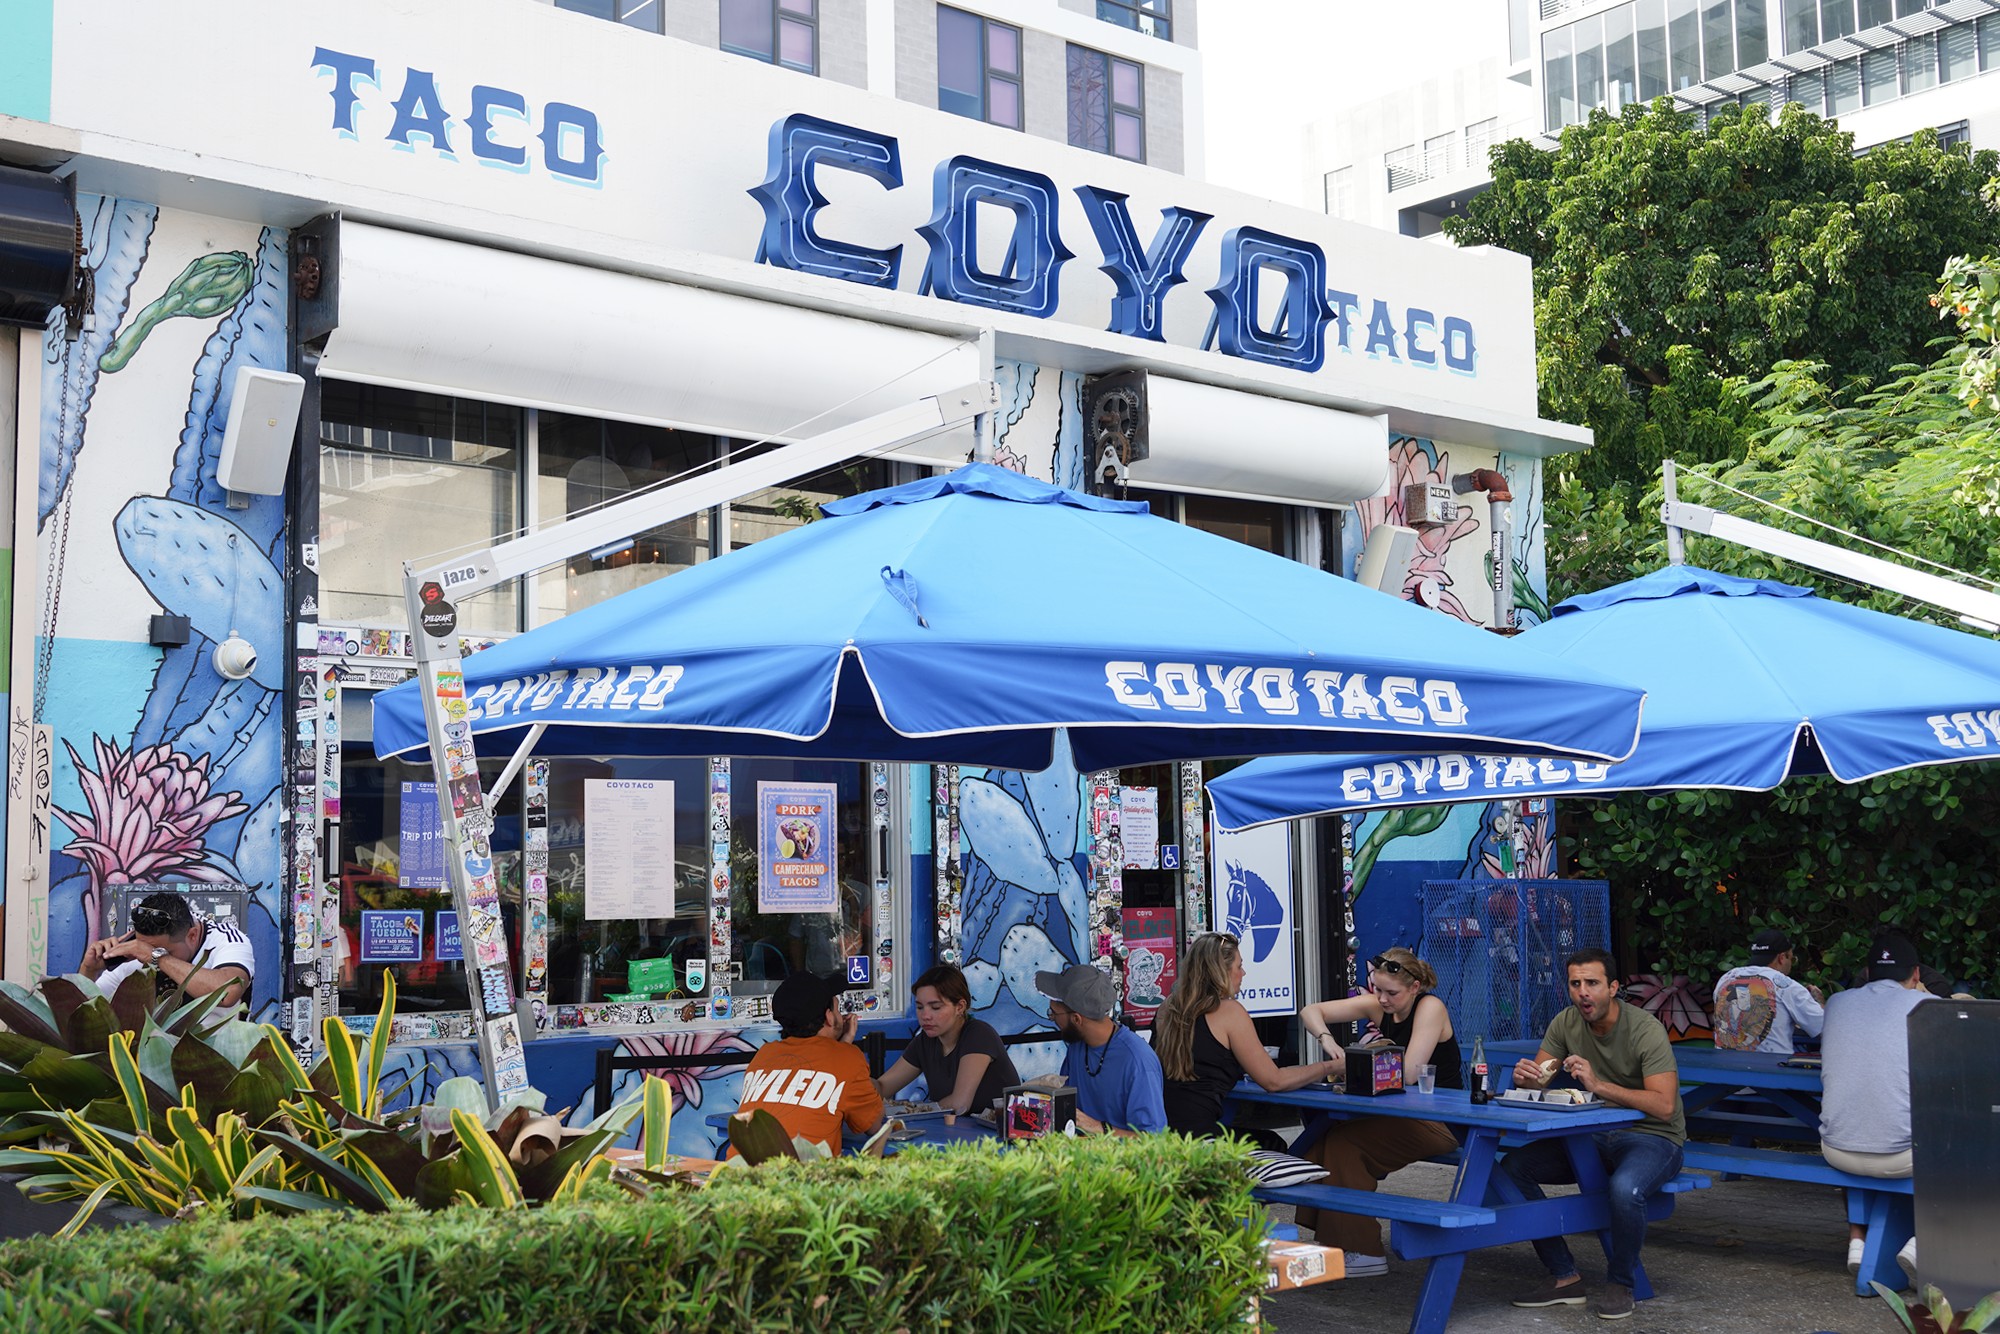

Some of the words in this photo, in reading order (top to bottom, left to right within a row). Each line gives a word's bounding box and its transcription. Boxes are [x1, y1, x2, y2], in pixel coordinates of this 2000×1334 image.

[310, 46, 610, 190] TACO
[746, 112, 1338, 373] COYO
[1325, 288, 1480, 377] TACO
[1431, 488, 1450, 498] NENA
[443, 567, 476, 587] jaze
[468, 670, 570, 721] COYO
[562, 665, 684, 711] TACO
[1105, 661, 1300, 716] COYO
[1302, 669, 1470, 727] TACO
[1339, 754, 1474, 801] COYO
[1475, 755, 1611, 789] TACO
[781, 805, 816, 815] PORK
[402, 831, 420, 841] TRIP
[422, 832, 433, 841] TO
[775, 864, 825, 875] CAMPECHANO
[782, 877, 818, 886] TACOS
[370, 920, 395, 928] TACO
[370, 929, 413, 937] TUESDAY
[1260, 987, 1290, 999] TACO
